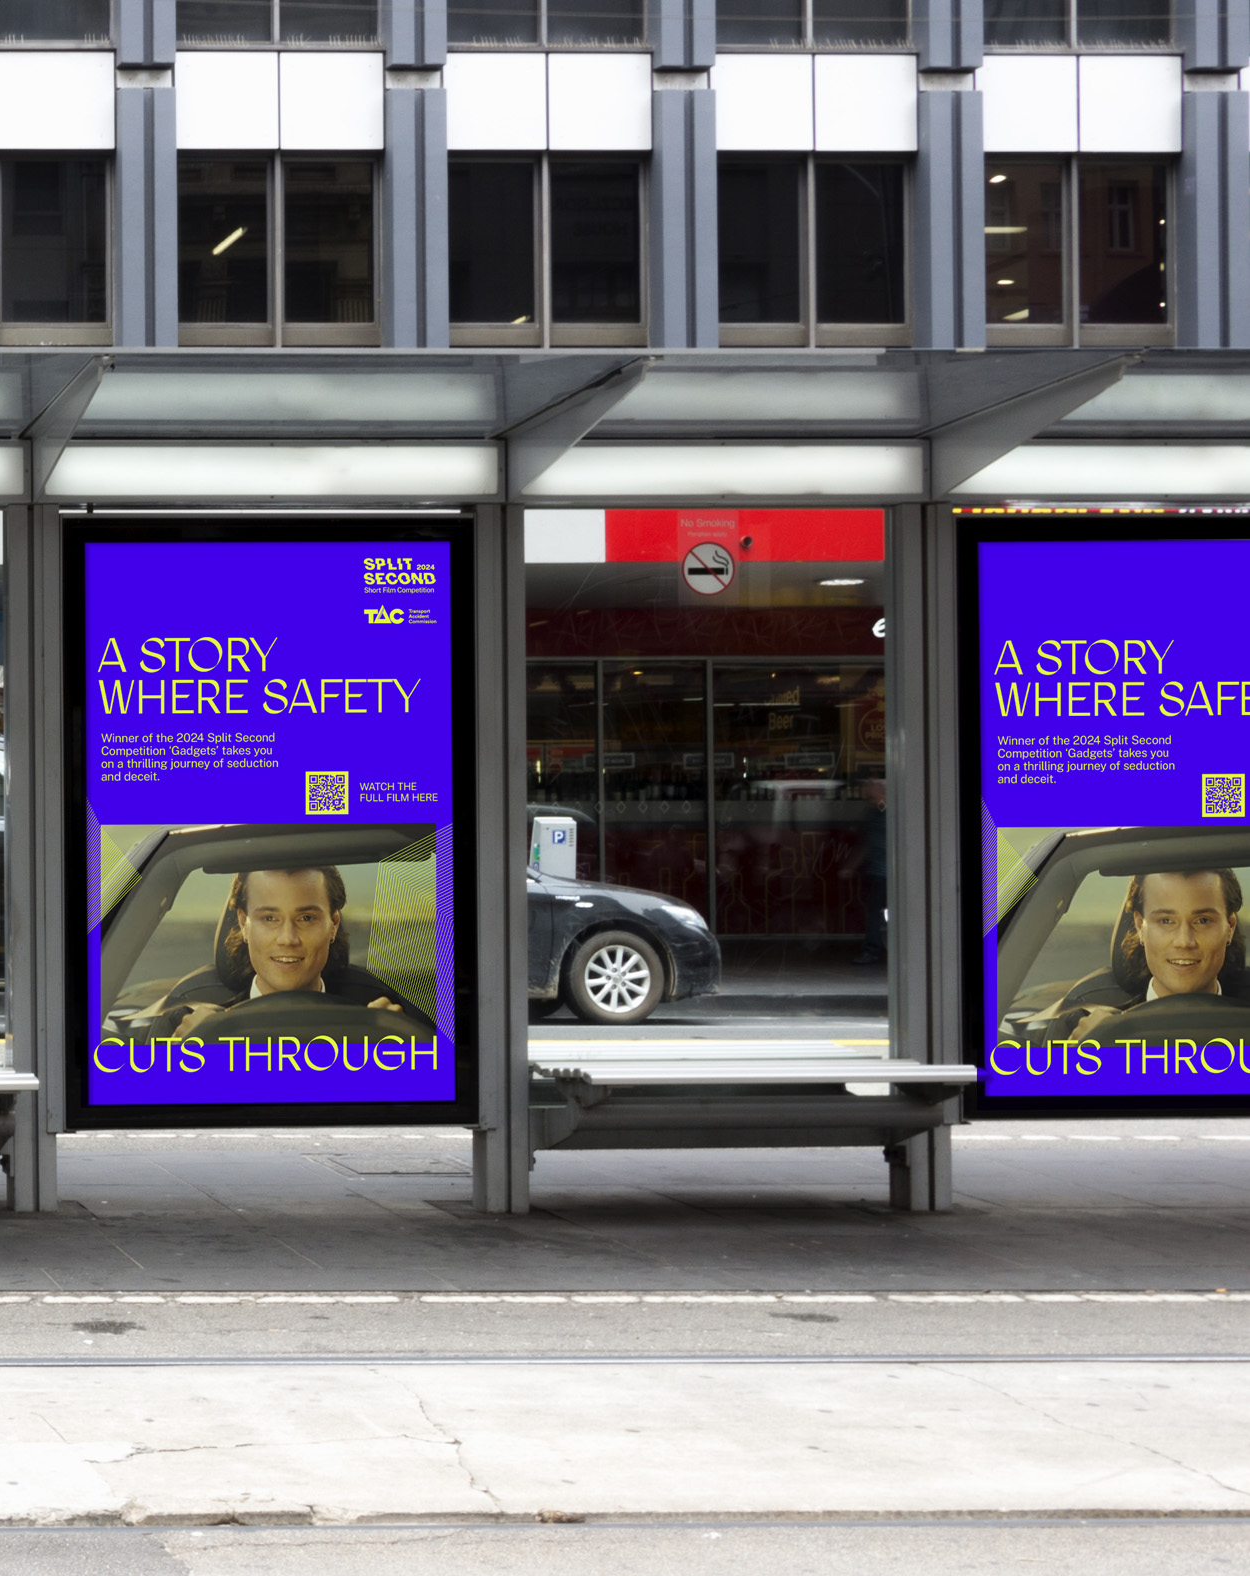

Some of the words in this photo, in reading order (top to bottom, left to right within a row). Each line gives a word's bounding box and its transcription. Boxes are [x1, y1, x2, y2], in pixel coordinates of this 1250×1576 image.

[681, 518, 694, 528] No
[695, 518, 735, 530] Smoking
[364, 557, 412, 570] SPLIT
[416, 563, 436, 571] 2024
[364, 572, 436, 585] SECOND
[363, 586, 382, 594] Short
[382, 586, 397, 594] Film
[396, 586, 435, 594] Competition
[364, 604, 404, 625] TAC
[408, 608, 431, 616] Transport
[408, 613, 430, 621] Accident
[98, 638, 127, 672] A
[140, 637, 277, 673] STORY
[994, 640, 1023, 675] A
[1036, 639, 1174, 675] STORY
[99, 679, 248, 714] WHERE
[263, 679, 421, 714] SAFETY
[995, 682, 1144, 716] WHERE
[769, 712, 794, 730] Beer
[101, 734, 139, 743] Winner
[142, 733, 153, 743] of
[156, 733, 173, 742] the
[177, 733, 204, 742] 2024
[208, 733, 231, 744] Split
[236, 733, 275, 742] Second
[998, 736, 1035, 745] Winner
[1039, 736, 1049, 745] of
[1053, 736, 1070, 745] the
[1073, 735, 1100, 745] 2024
[1104, 735, 1128, 746] Split
[1132, 735, 1171, 745] Second
[101, 746, 165, 757] Competition
[222, 746, 251, 755] takes
[254, 748, 272, 757] you
[998, 749, 1062, 759] Competition
[1119, 748, 1147, 757] takes
[1150, 750, 1168, 759] you
[100, 760, 115, 769] on
[117, 760, 124, 769] a
[127, 759, 167, 770] thrilling
[170, 759, 210, 770] journey
[213, 758, 224, 768] of
[227, 758, 278, 768] seduction
[997, 763, 1011, 772] on
[1013, 763, 1020, 772] a
[1024, 761, 1064, 772] thrilling
[1067, 761, 1106, 772] journey
[1110, 761, 1120, 770] of
[1124, 761, 1175, 770] seduction
[101, 772, 120, 781] and
[124, 772, 159, 781] deceit.
[998, 774, 1017, 784] and
[1021, 774, 1056, 783] deceit.
[360, 782, 394, 790] WATCH
[398, 782, 416, 790] THE
[360, 794, 383, 802] FULL
[386, 793, 410, 802] FILM
[413, 793, 438, 801] HERE
[93, 1036, 205, 1073] CUTS
[219, 1035, 436, 1072] THROUGH
[990, 1039, 1102, 1076] CUTS
